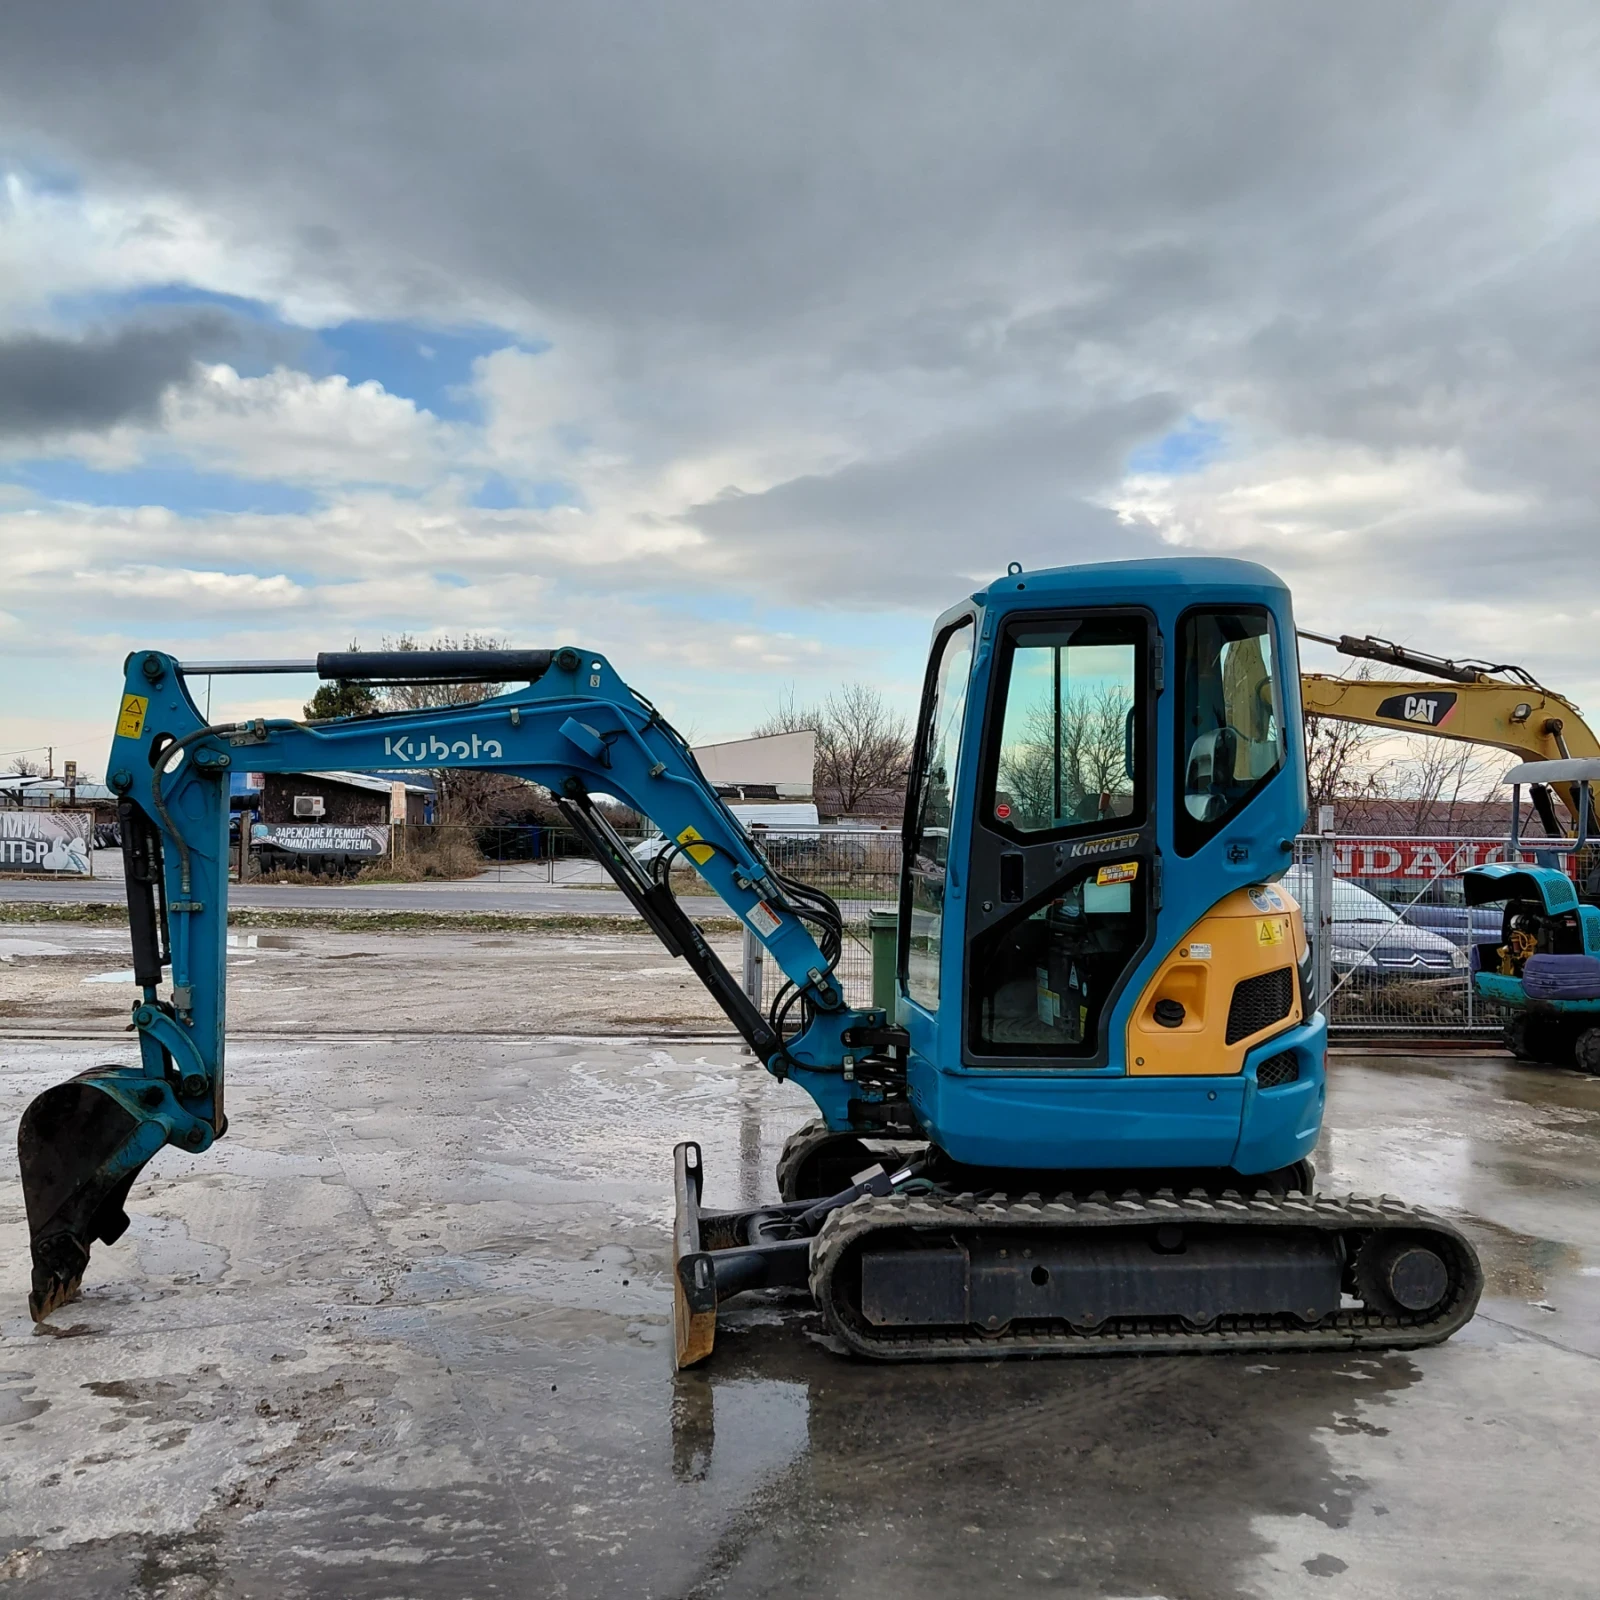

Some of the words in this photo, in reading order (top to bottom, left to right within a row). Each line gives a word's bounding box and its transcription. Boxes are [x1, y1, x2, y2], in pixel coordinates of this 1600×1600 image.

[1404, 696, 1437, 723] CAT
[385, 734, 502, 761] Kubota
[0, 814, 40, 838] МИ
[275, 827, 324, 839] ЗАРЕЖДАНЕ
[326, 827, 333, 838] И
[334, 828, 366, 838] РЕМОНТ
[279, 837, 333, 849] КЛИМАТИЧНА
[334, 838, 372, 850] СИСТЕМА
